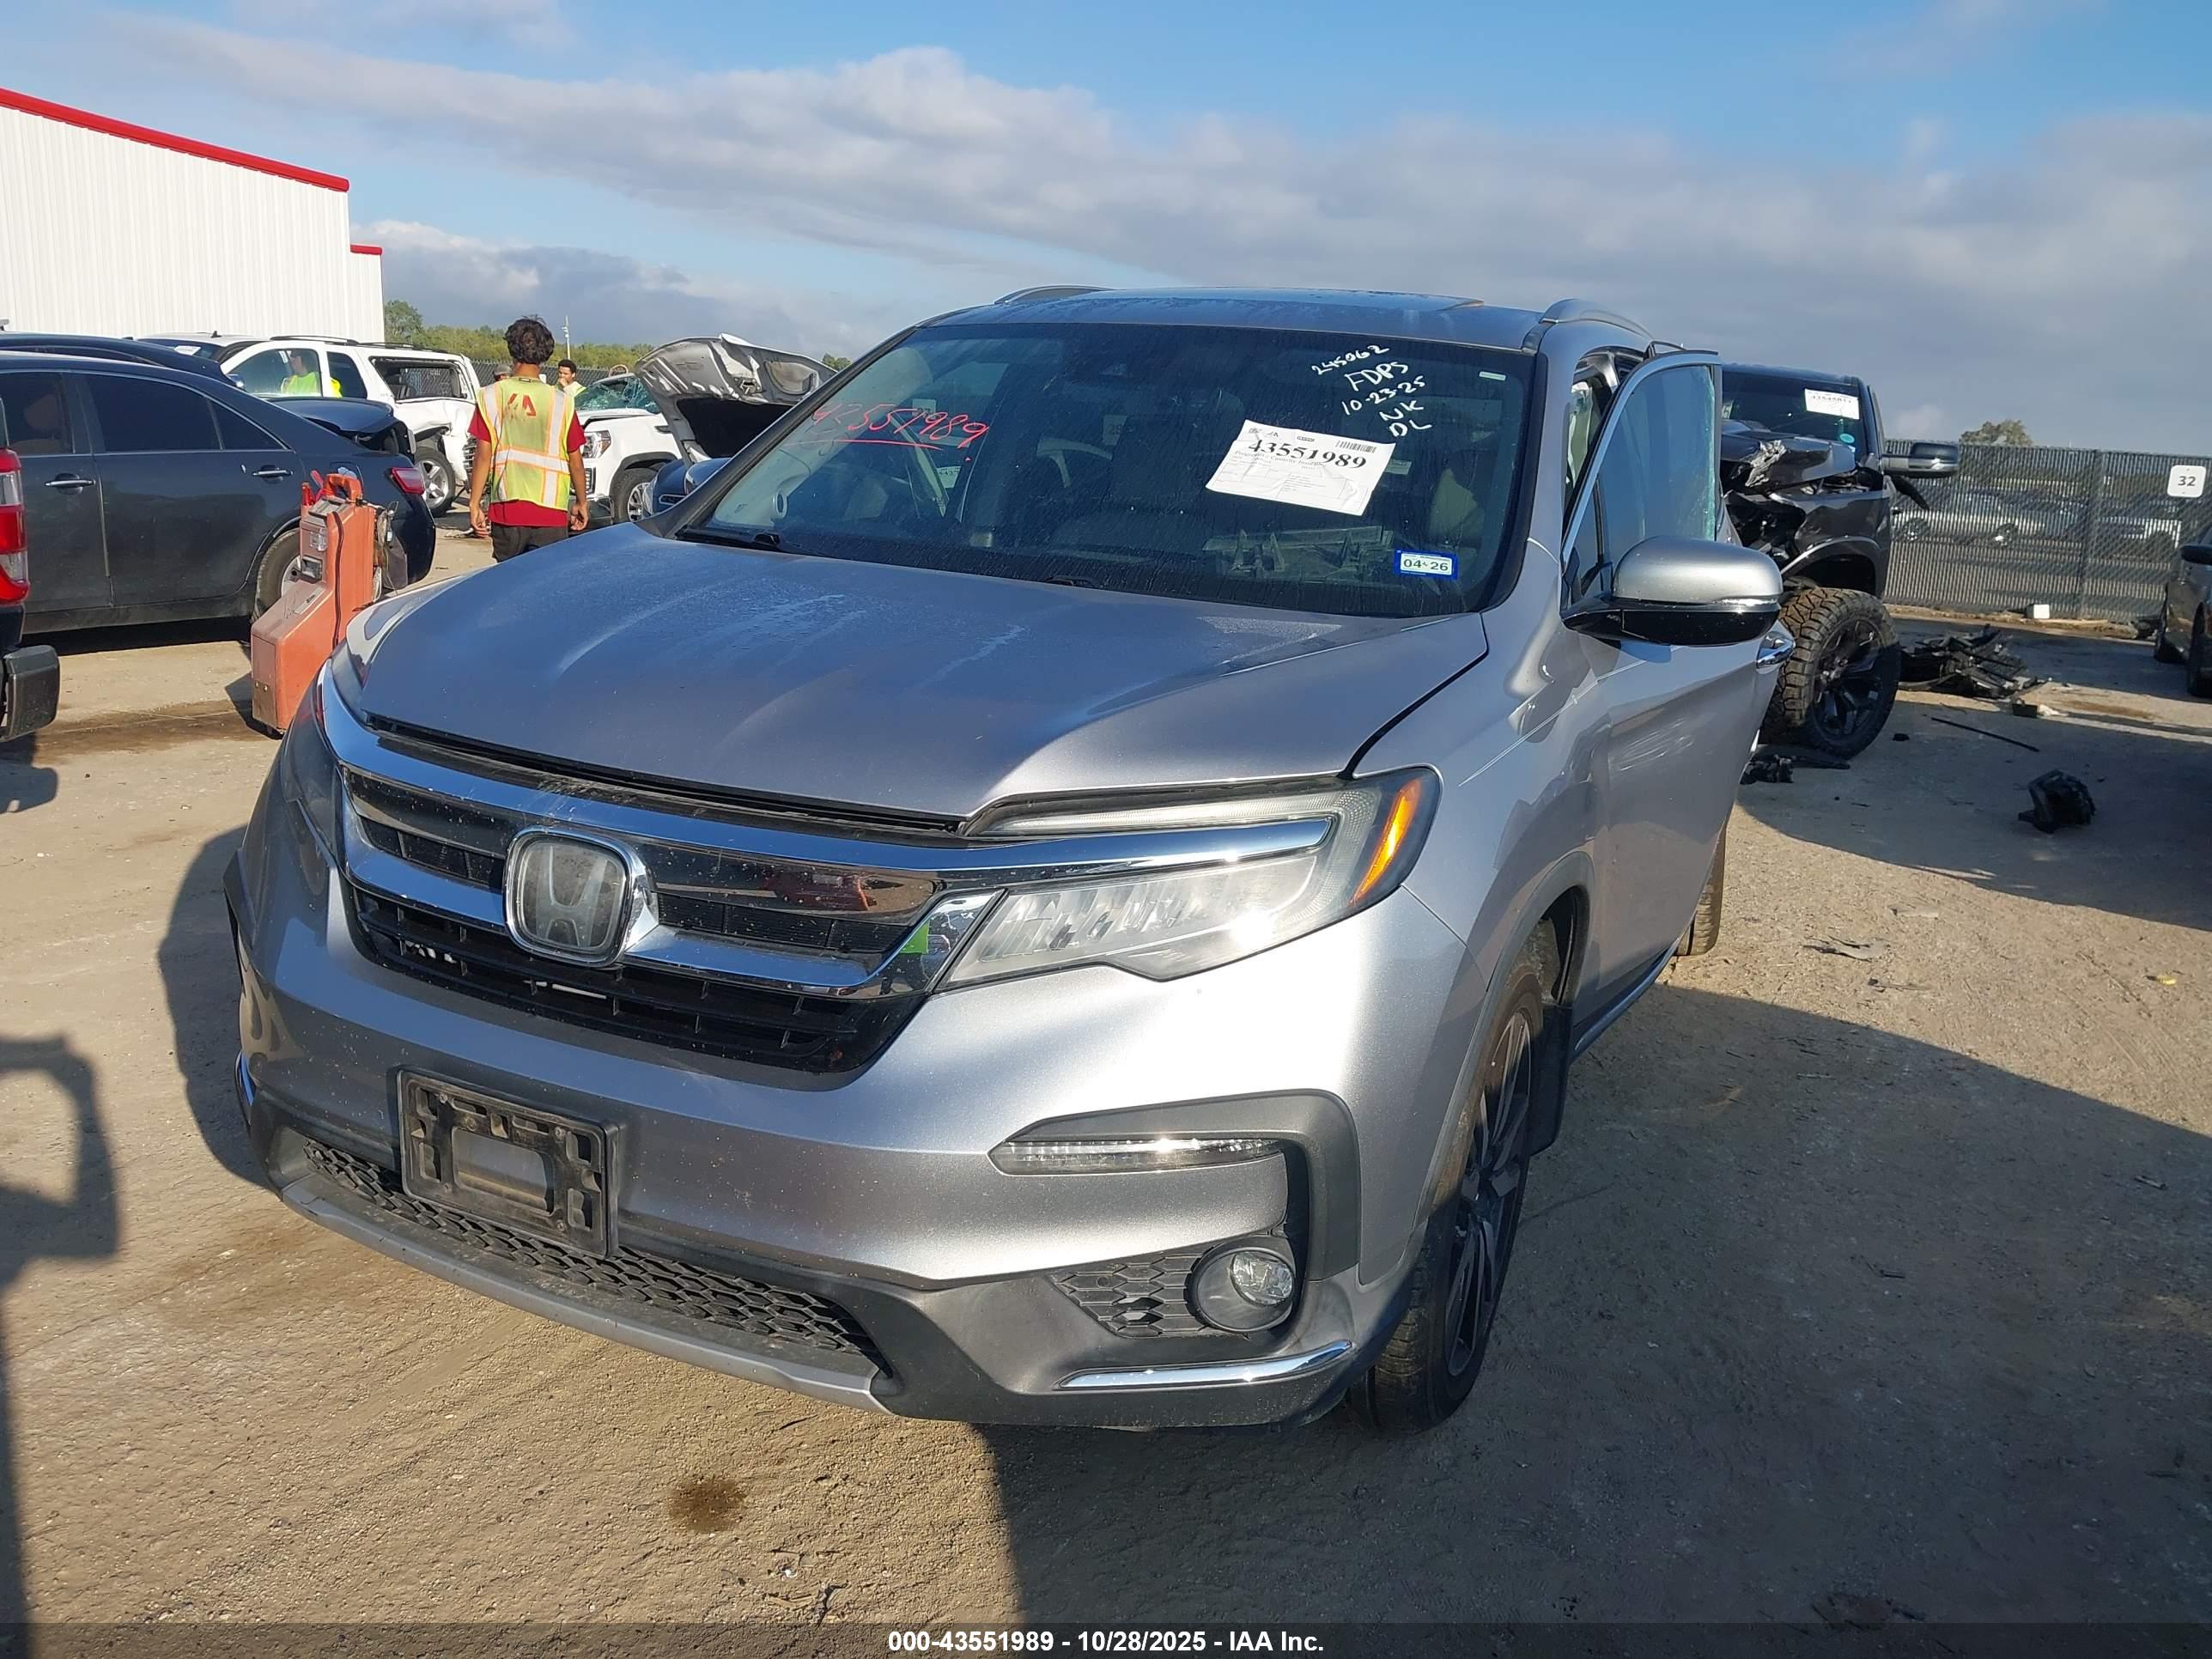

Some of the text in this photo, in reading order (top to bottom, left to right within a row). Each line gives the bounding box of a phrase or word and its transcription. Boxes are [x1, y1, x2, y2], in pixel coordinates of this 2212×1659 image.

[1248, 439, 1367, 469] 43551989
[2177, 475, 2197, 487] 32
[1403, 558, 1449, 571] 04 26
